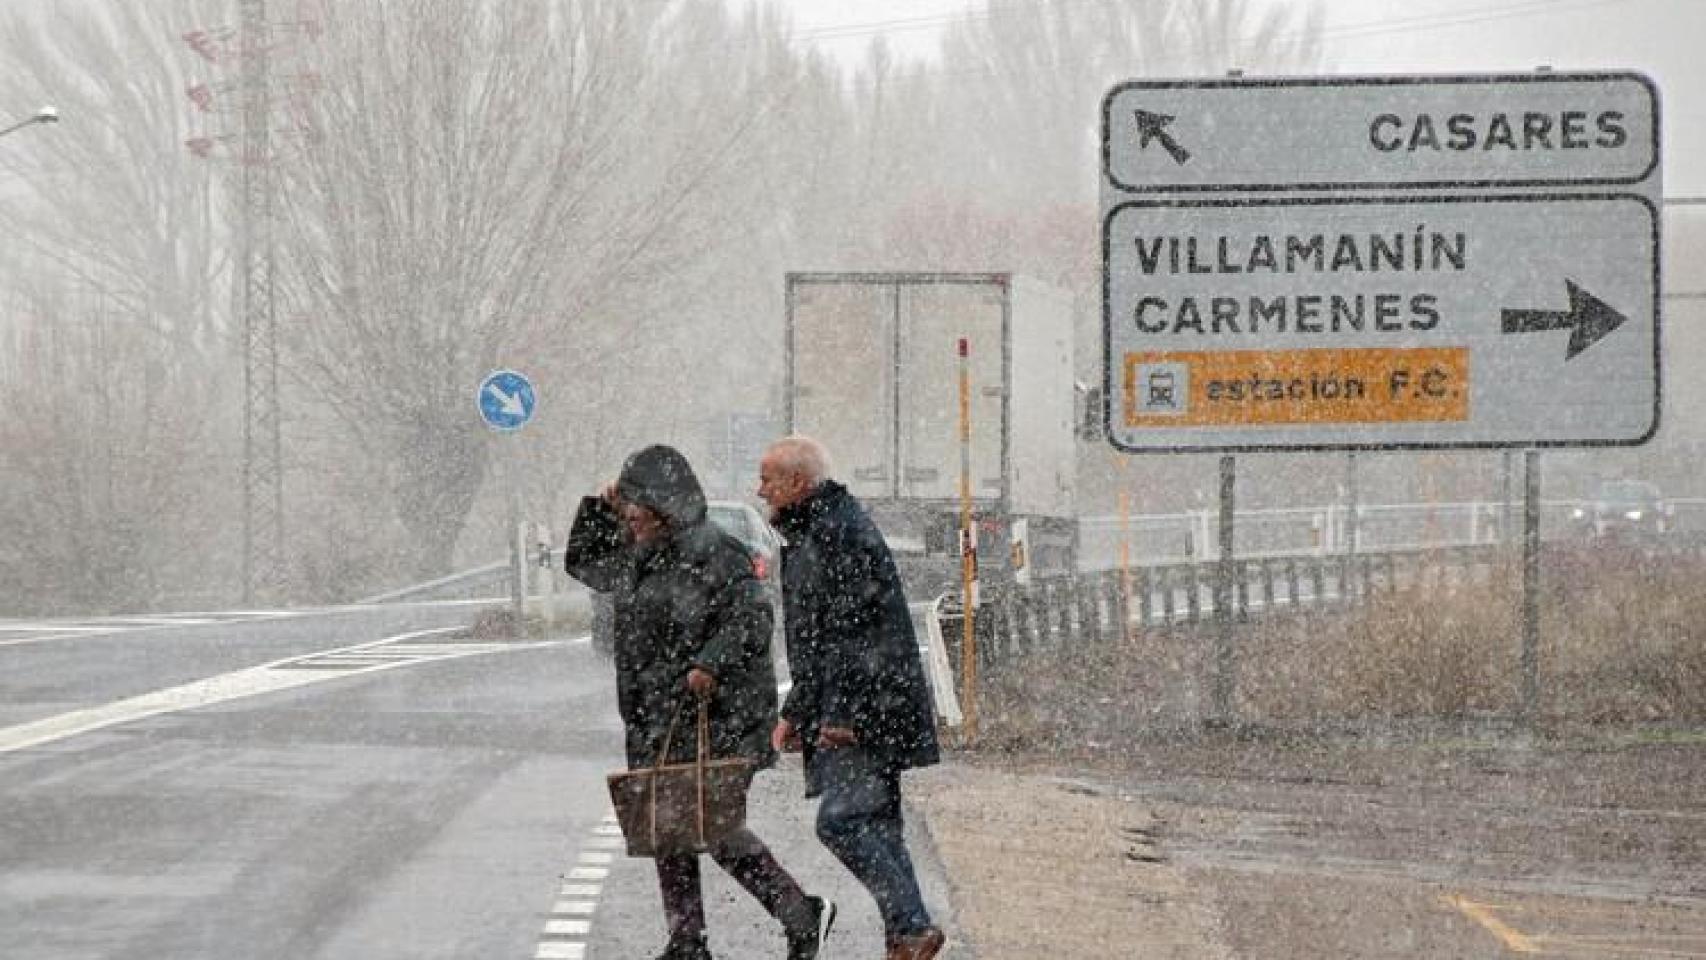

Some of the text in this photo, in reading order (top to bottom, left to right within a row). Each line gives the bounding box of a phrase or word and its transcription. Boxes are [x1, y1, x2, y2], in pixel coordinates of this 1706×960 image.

[1369, 111, 1628, 152] CASARES
[1134, 225, 1467, 274] VILLAMANÍN
[1134, 294, 1441, 334] CARMENES
[1206, 368, 1461, 401] estación F.C.
